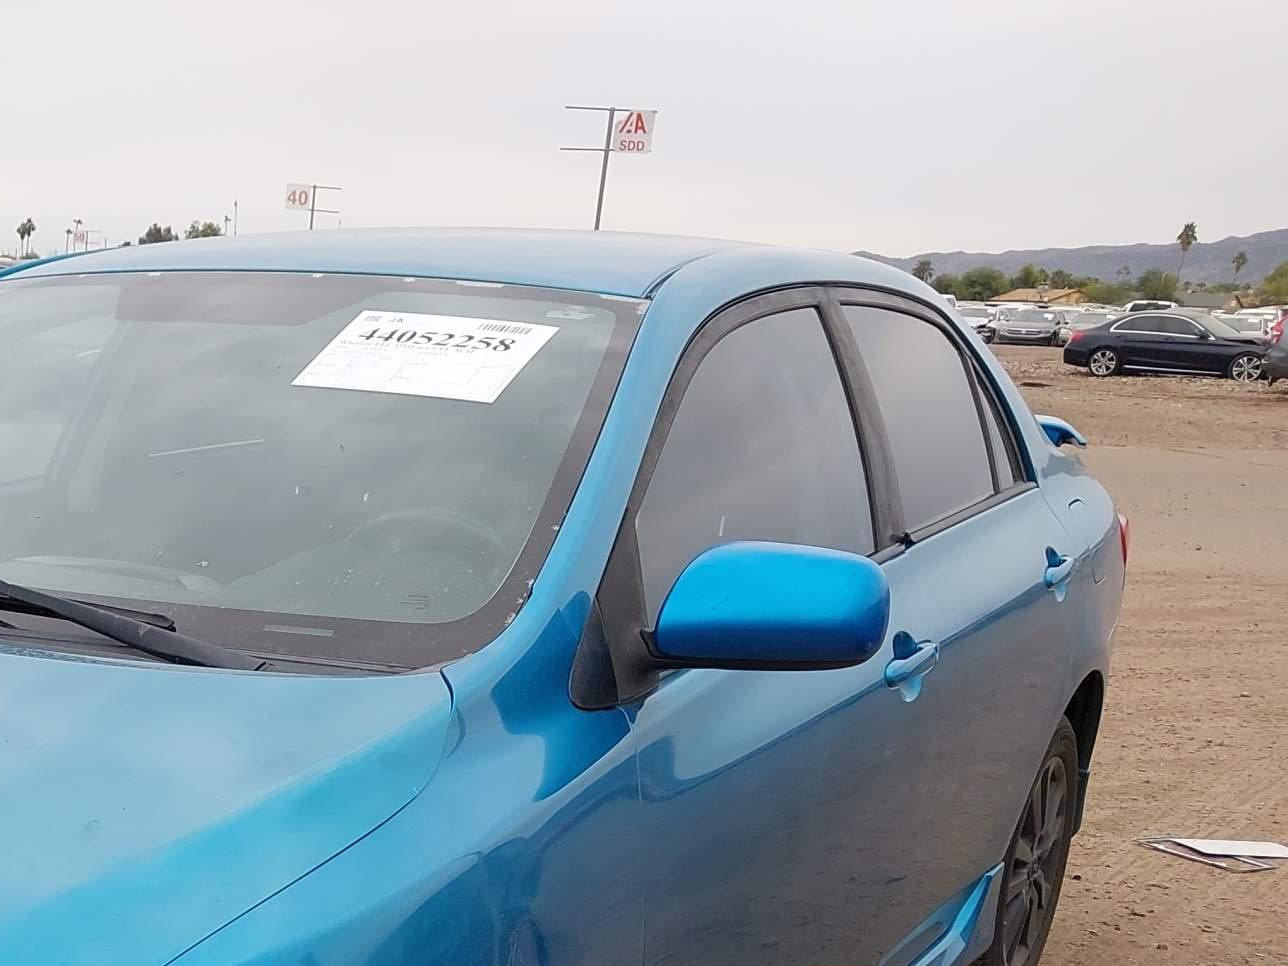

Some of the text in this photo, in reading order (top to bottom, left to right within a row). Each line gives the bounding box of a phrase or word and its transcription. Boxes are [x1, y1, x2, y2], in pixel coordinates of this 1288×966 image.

[619, 139, 645, 151] SDD
[287, 190, 309, 206] 40
[359, 327, 516, 352] 44052258
